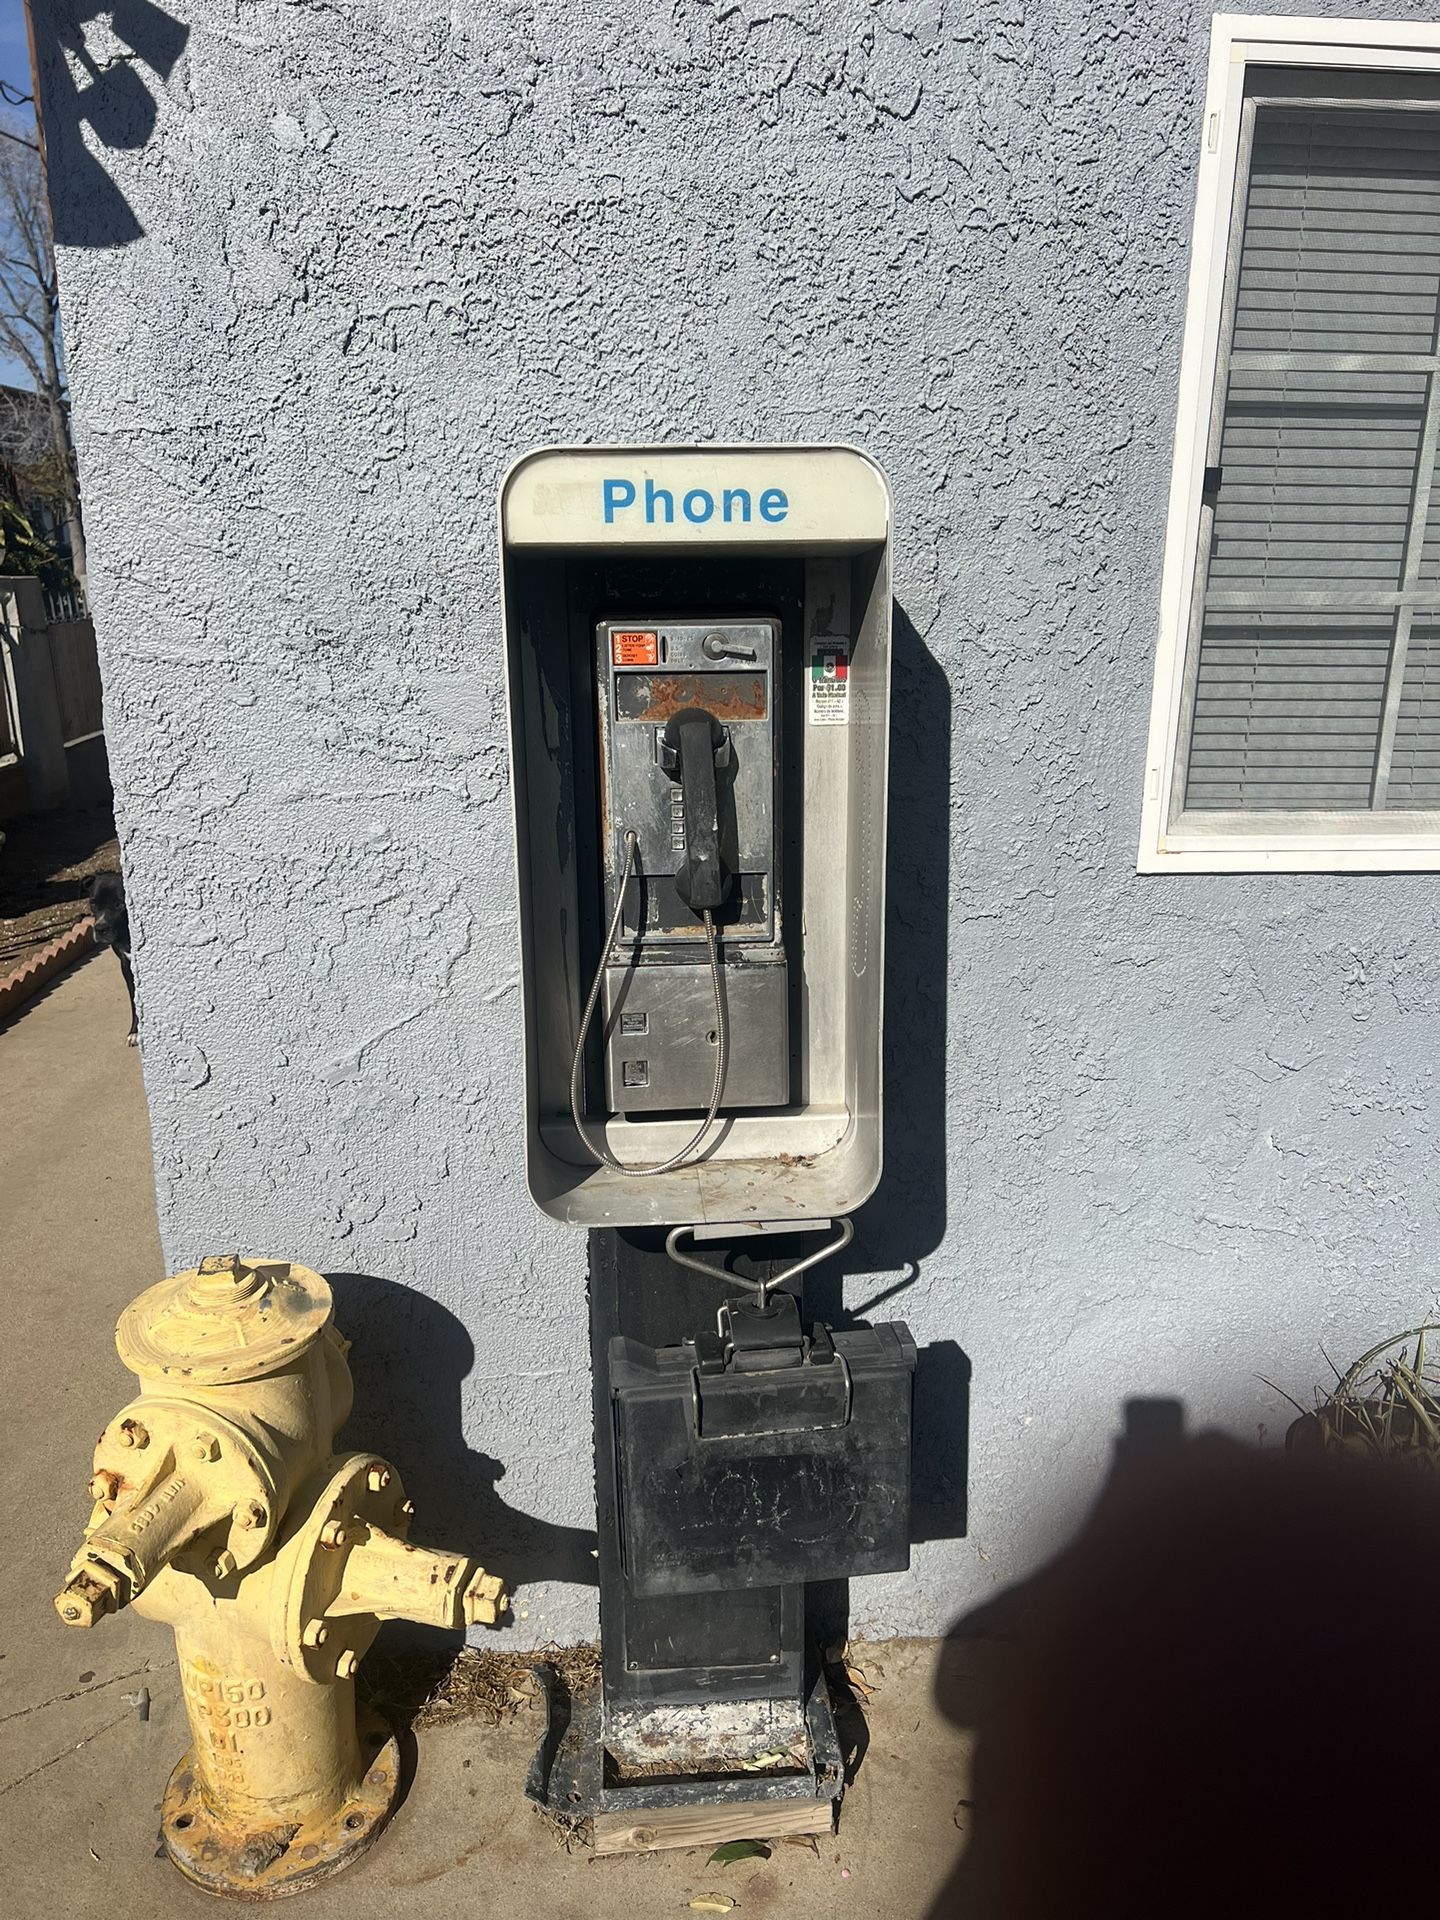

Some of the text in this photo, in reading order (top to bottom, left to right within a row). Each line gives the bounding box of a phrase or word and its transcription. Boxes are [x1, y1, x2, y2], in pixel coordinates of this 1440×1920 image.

[603, 479, 789, 523] Phone
[615, 634, 621, 643] 1
[615, 643, 622, 653] 2
[615, 653, 622, 664] 3
